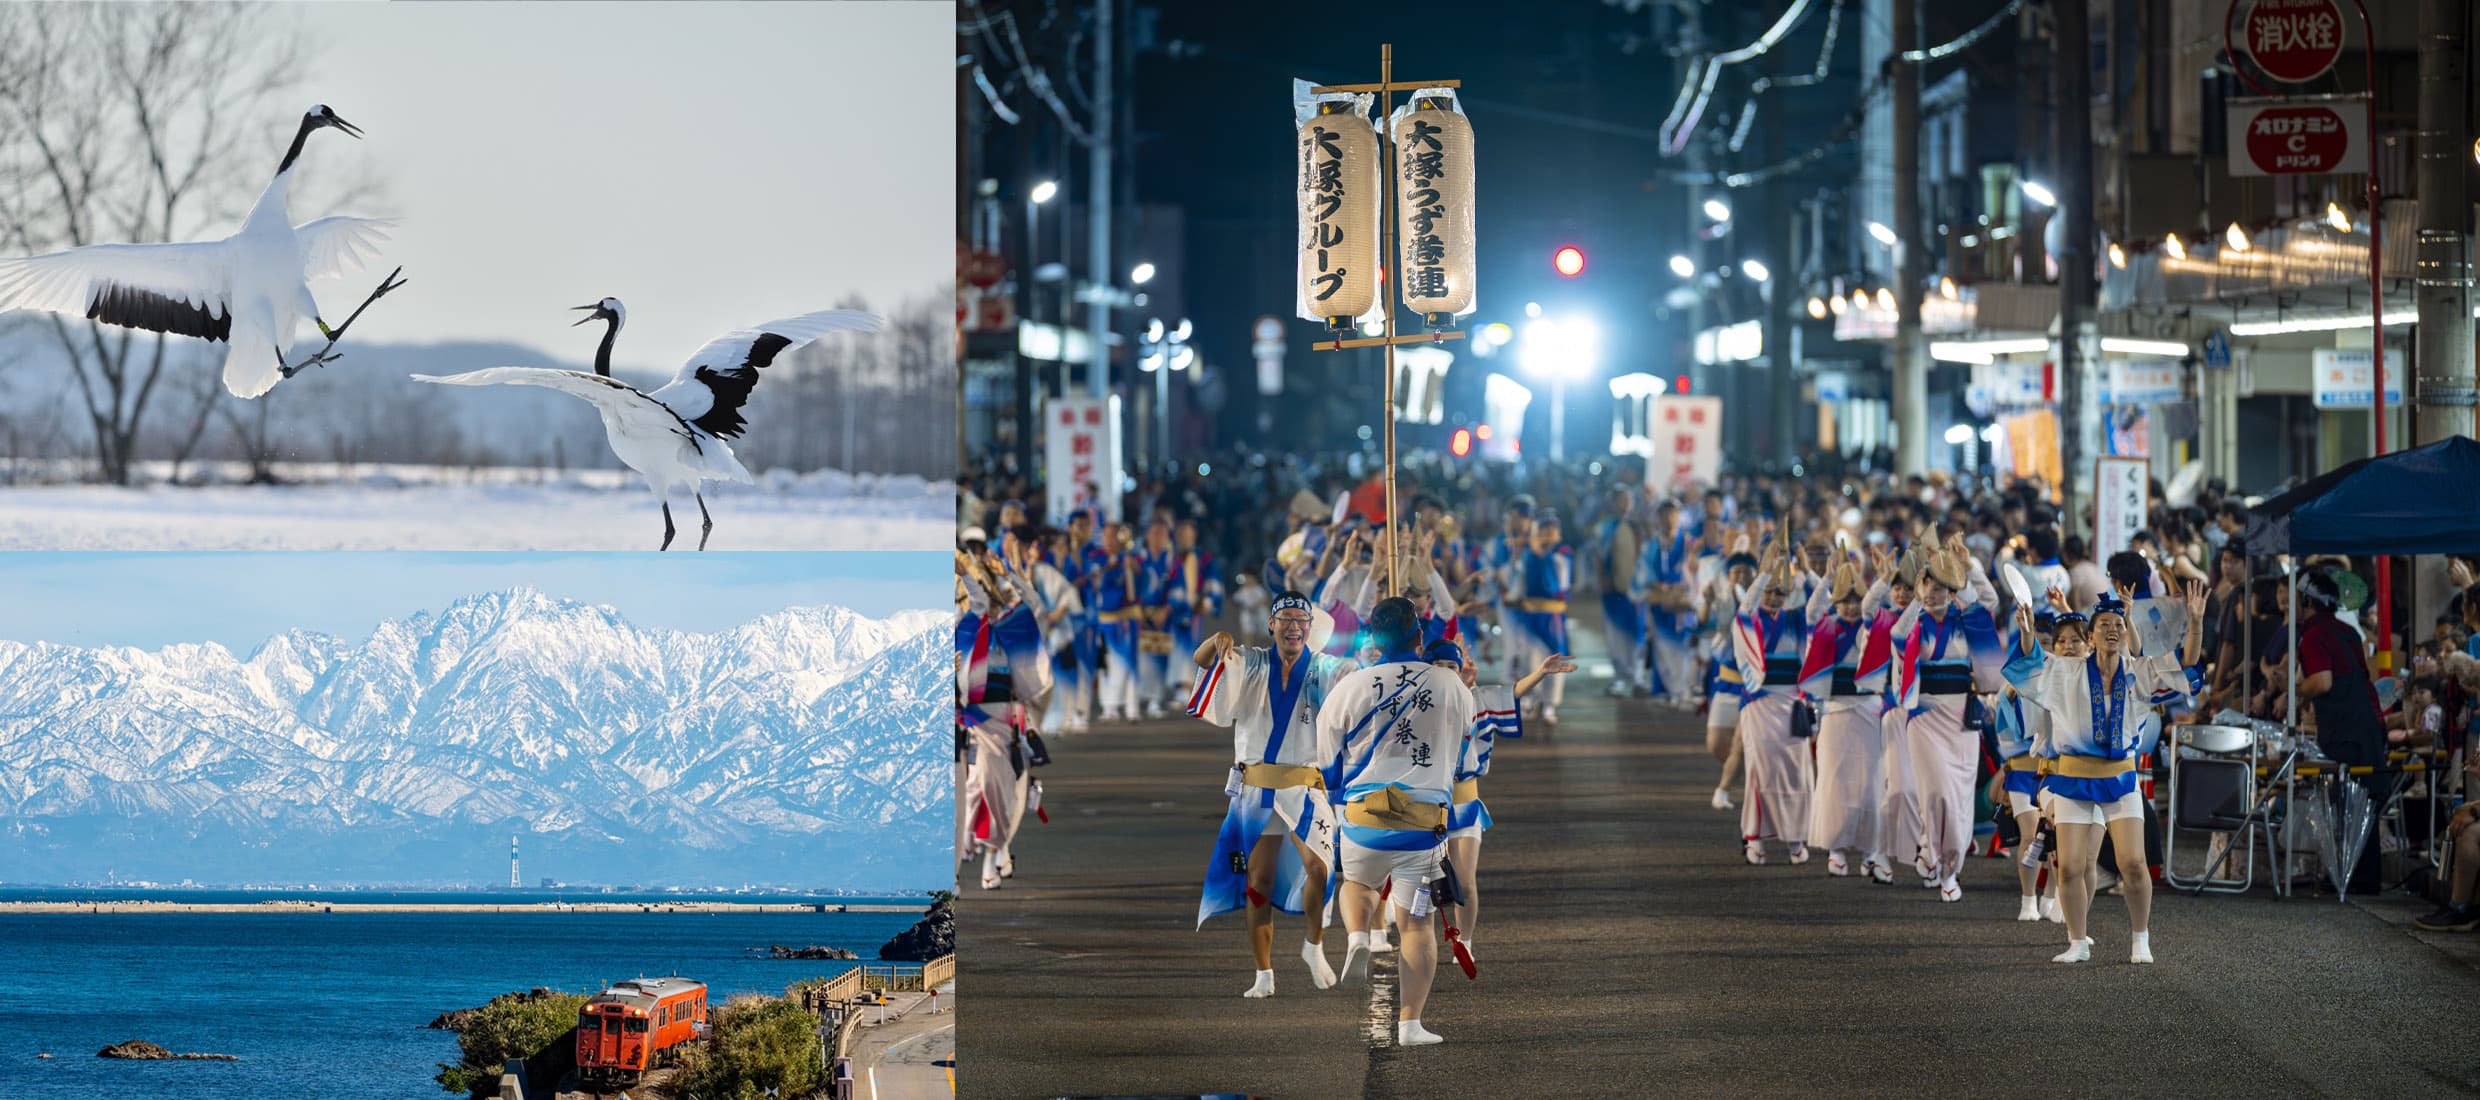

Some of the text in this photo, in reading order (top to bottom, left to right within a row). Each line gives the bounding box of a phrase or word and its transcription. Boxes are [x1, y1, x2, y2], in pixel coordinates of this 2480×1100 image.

[2255, 12, 2335, 53] 消火栓
[2255, 117, 2338, 135] オロナミン
[2287, 135, 2306, 152] C
[2276, 154, 2321, 168] ドリンク
[1303, 126, 1347, 301] 大塚グループ
[1404, 120, 1449, 299] 大塚うず巻連
